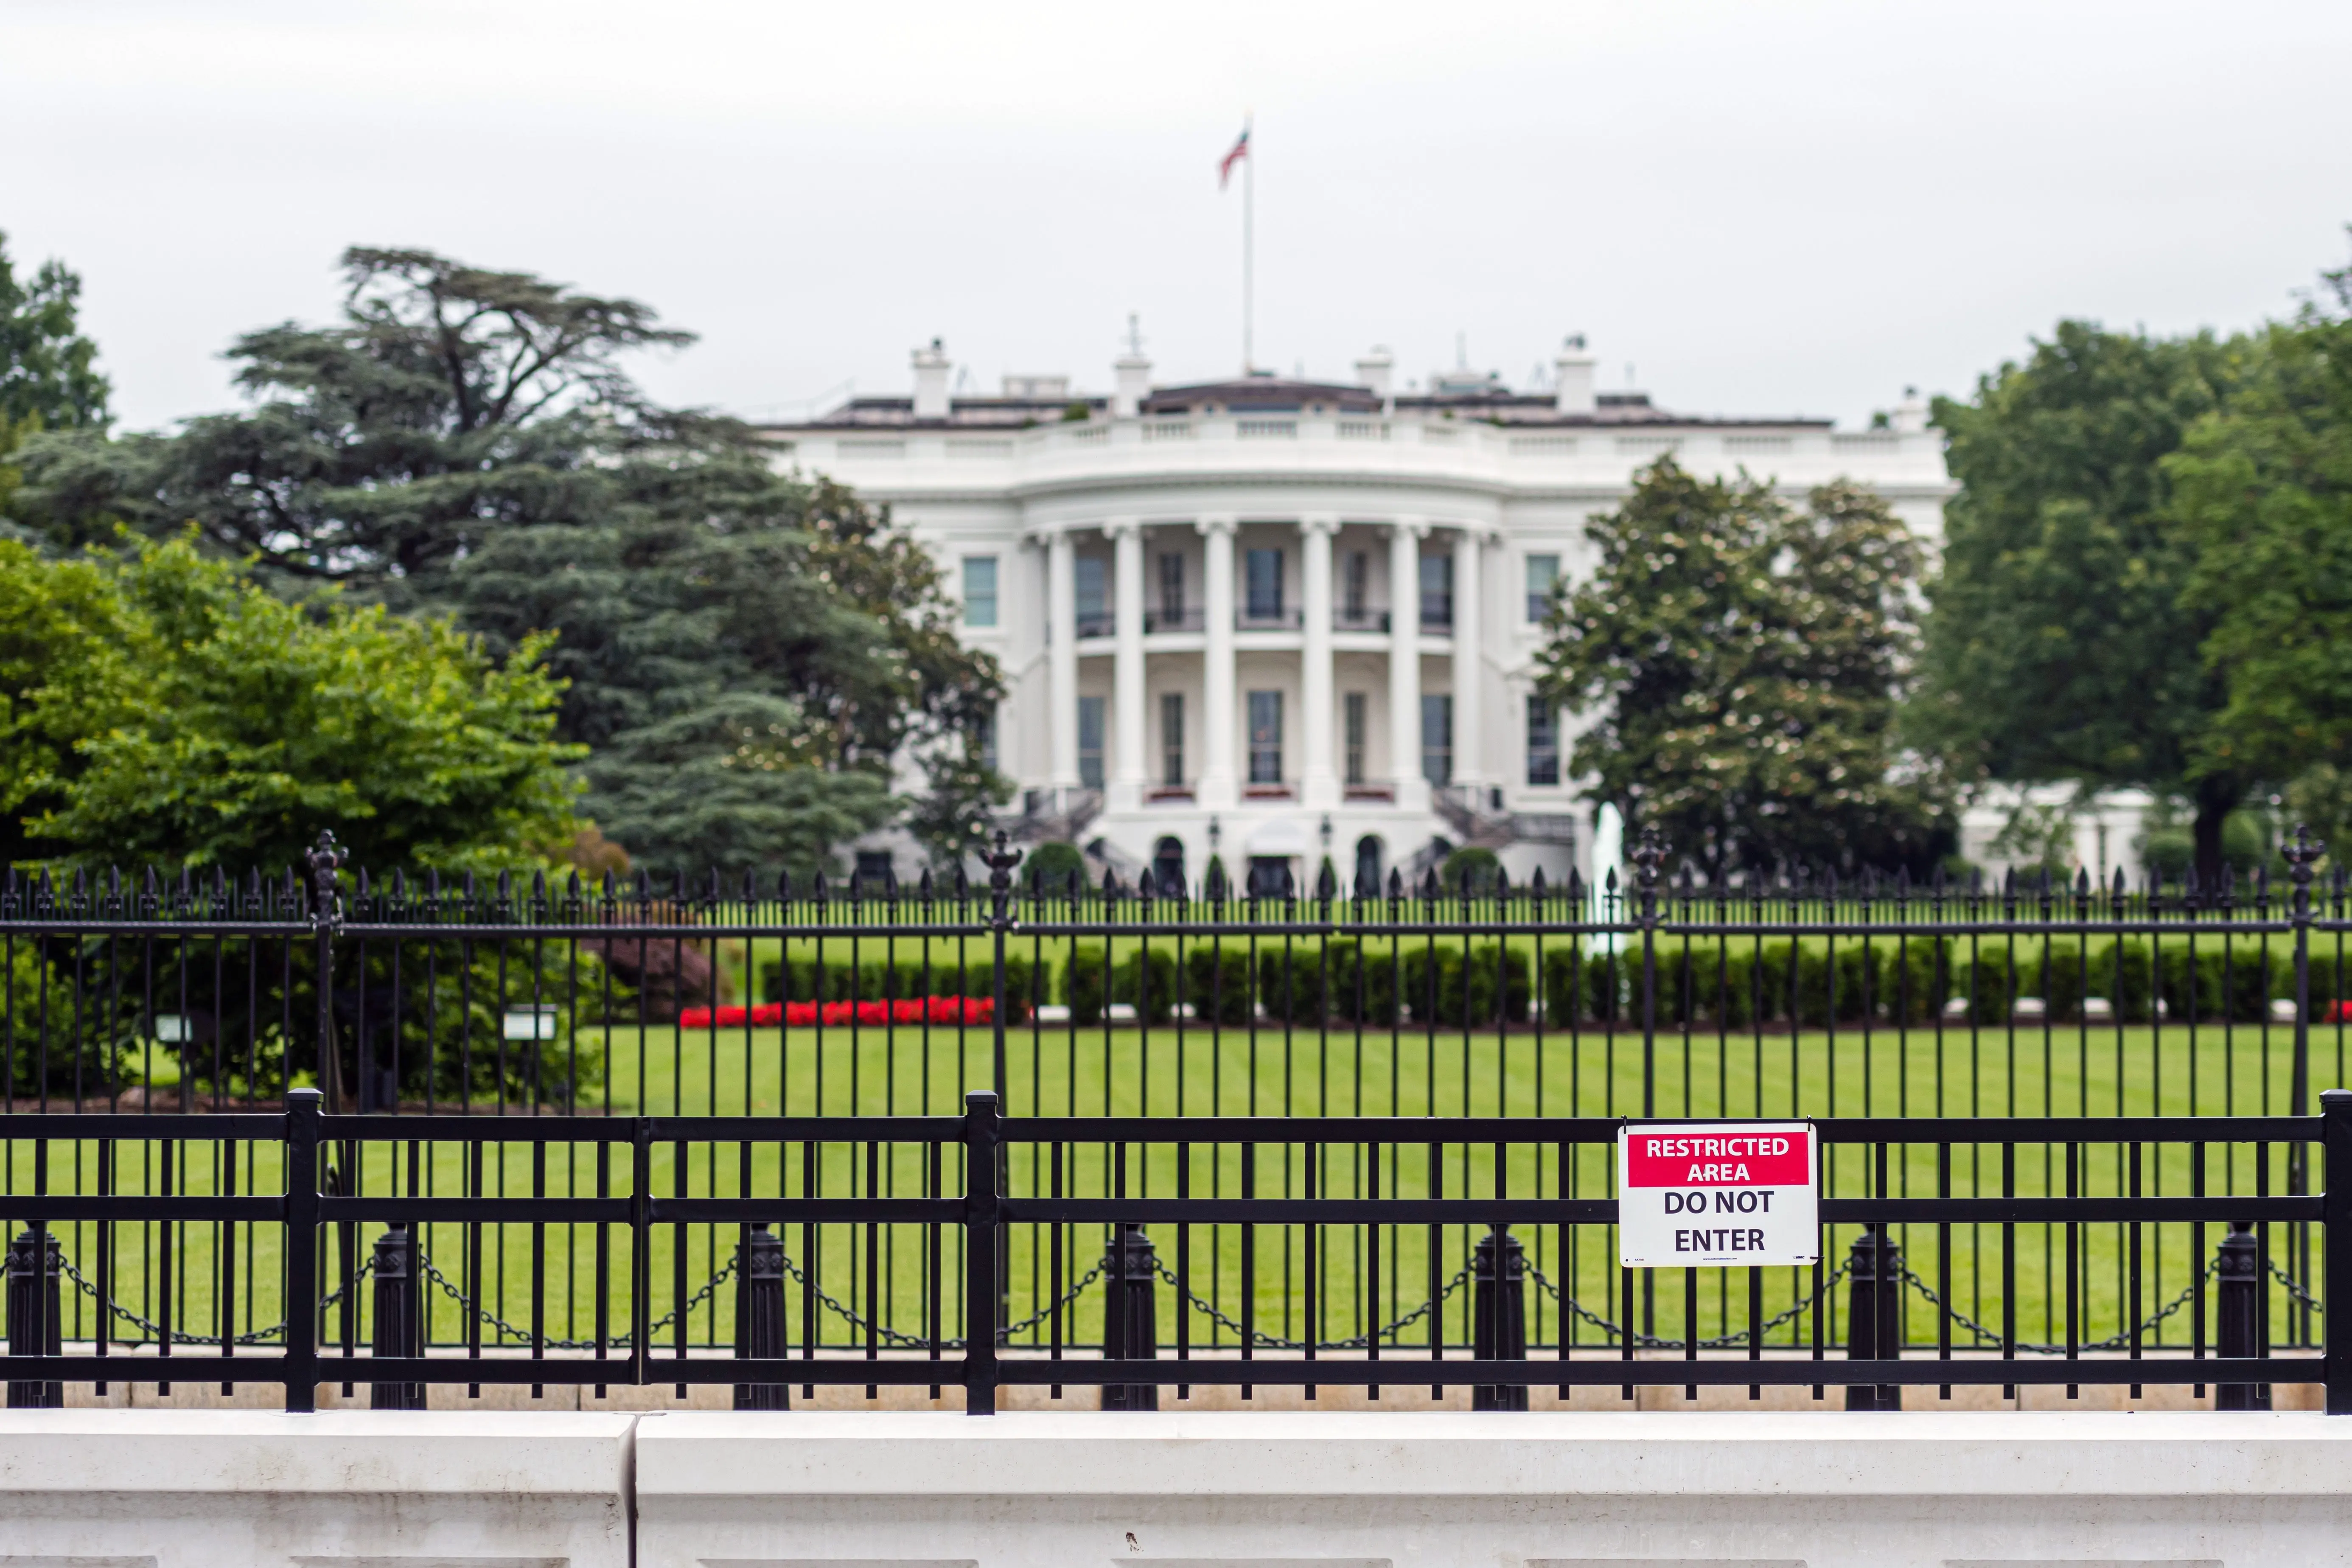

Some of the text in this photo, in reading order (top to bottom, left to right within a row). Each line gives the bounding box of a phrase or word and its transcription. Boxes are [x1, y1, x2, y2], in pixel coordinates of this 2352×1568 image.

[1647, 1138, 1789, 1157] RESTRICTED
[1687, 1163, 1750, 1181] AREA
[1665, 1190, 1775, 1214] DO NOT
[1675, 1229, 1765, 1252] ENTER
